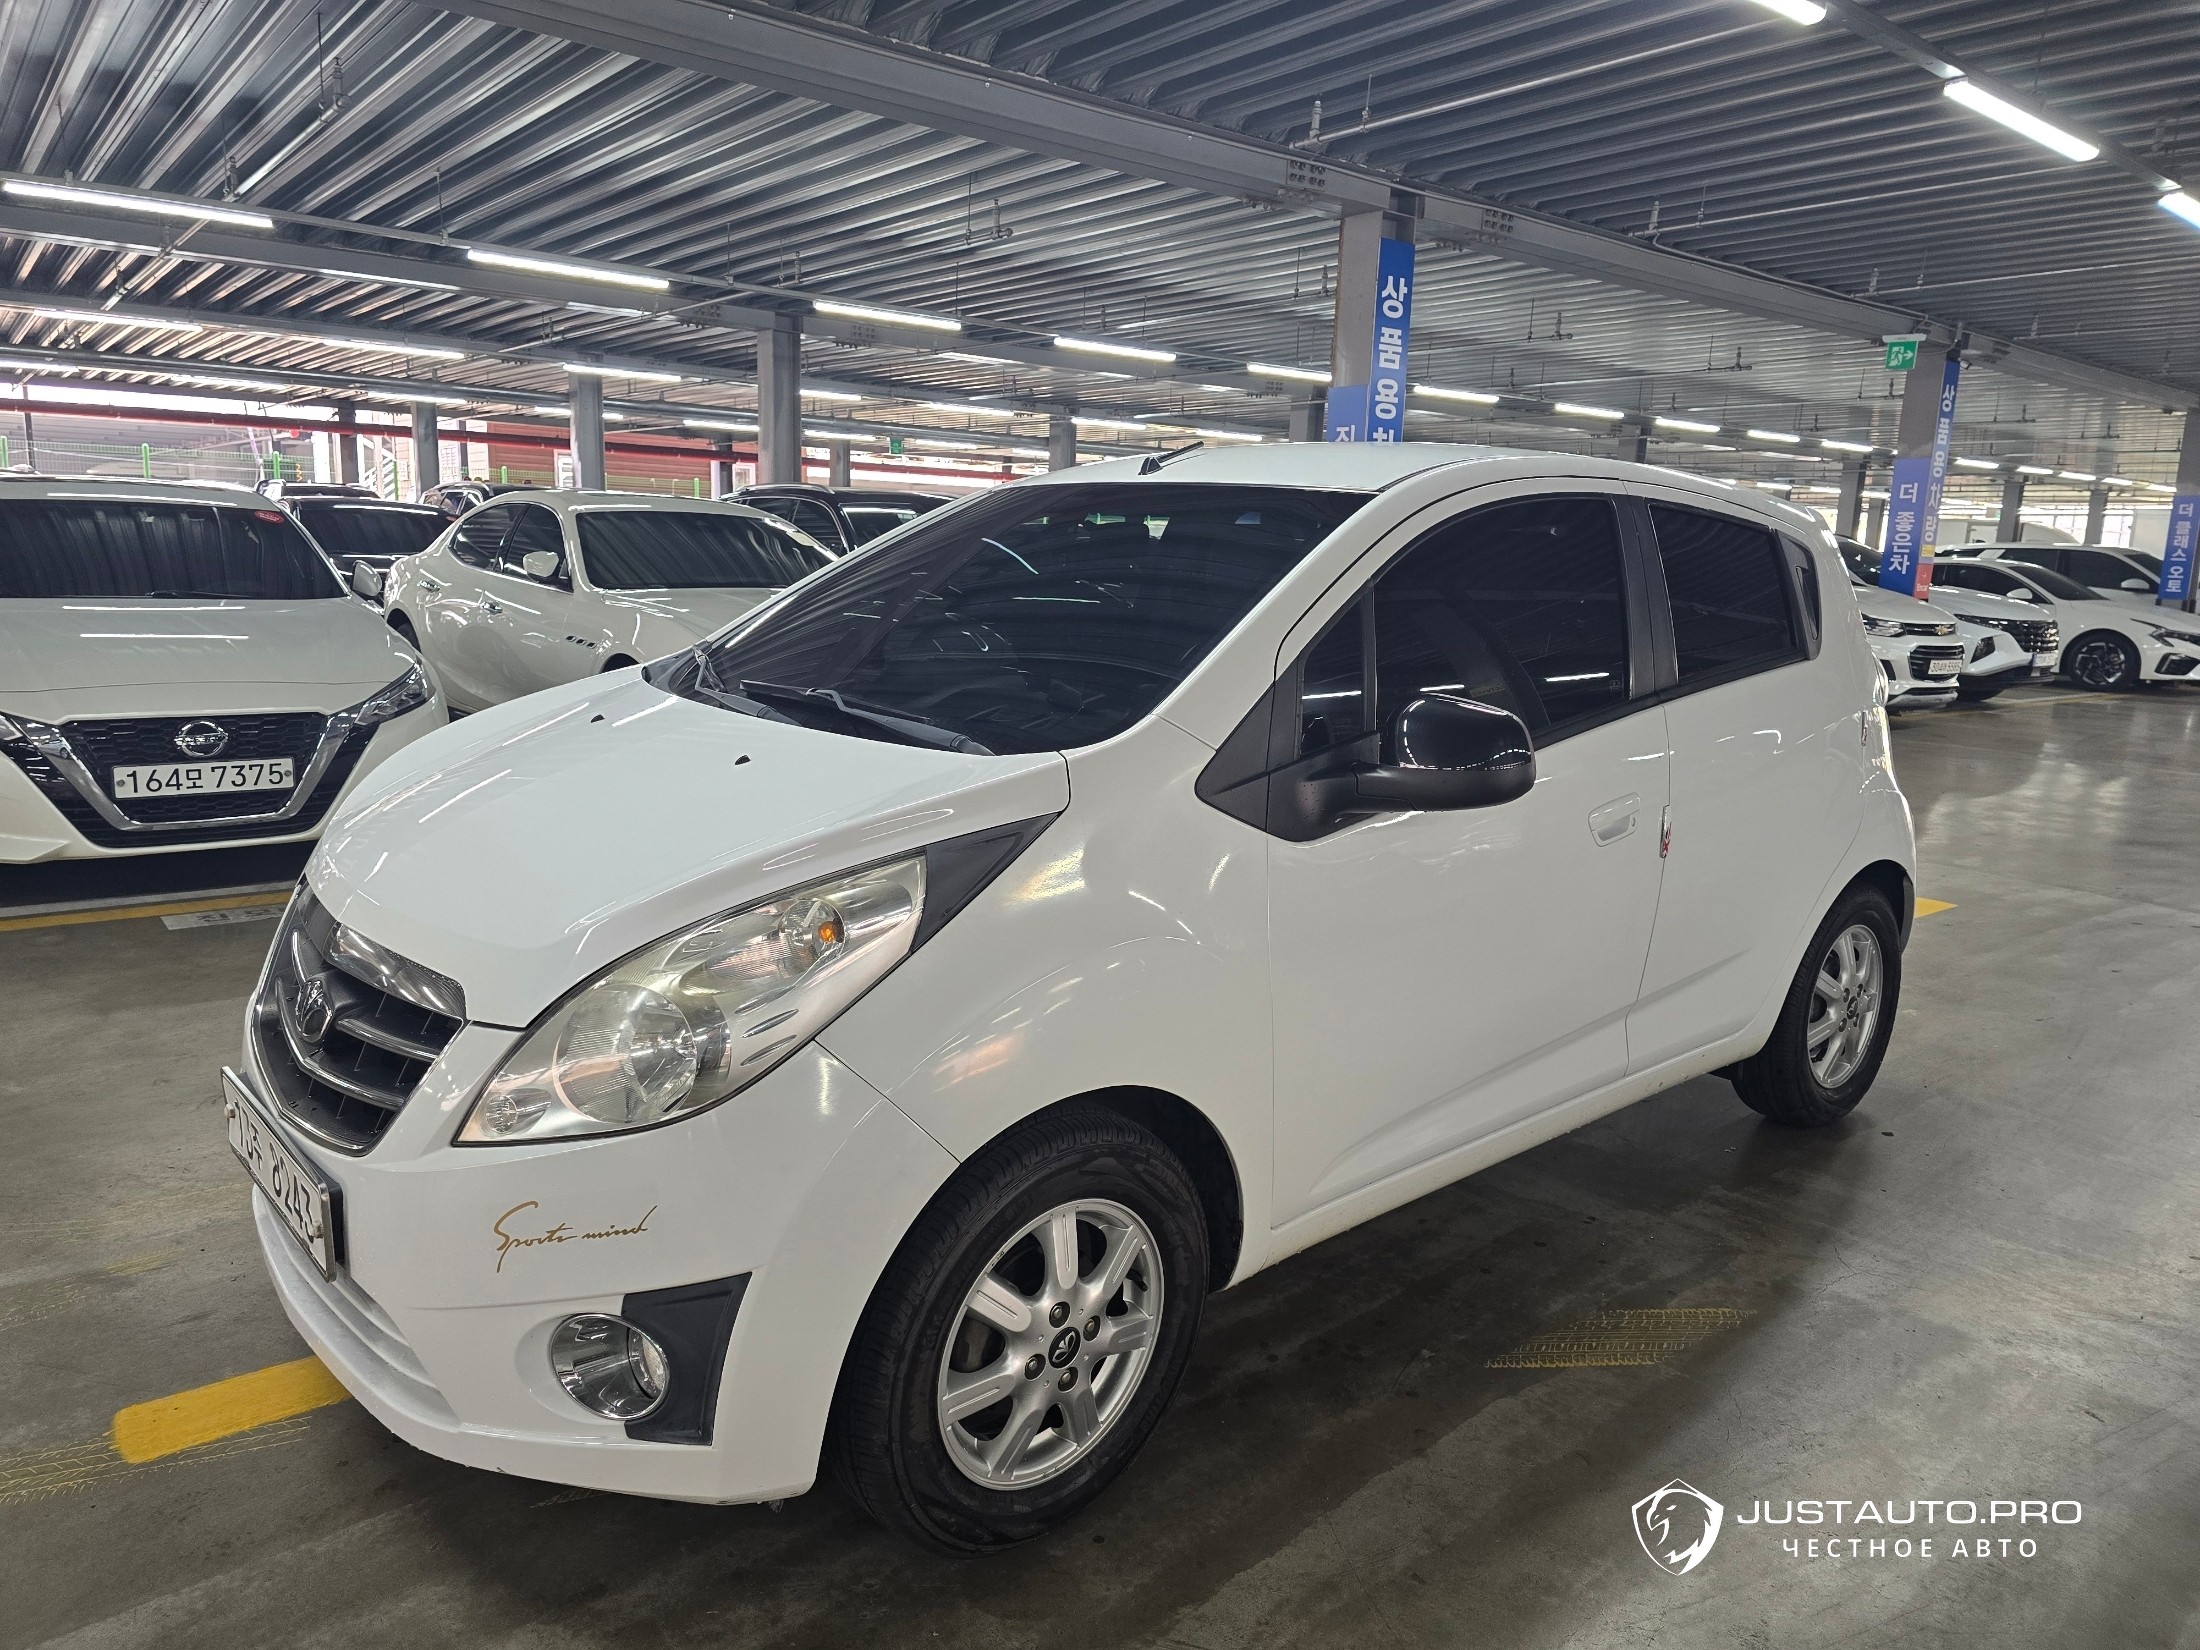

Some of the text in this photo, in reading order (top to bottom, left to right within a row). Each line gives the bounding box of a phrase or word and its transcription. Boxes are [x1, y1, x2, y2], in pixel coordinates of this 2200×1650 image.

[1888, 482, 1919, 575] 더 좋은차
[2178, 503, 2194, 517] 더
[2165, 565, 2184, 593] 오토
[126, 762, 284, 794] 164모 7375
[269, 1141, 315, 1244] 8243
[493, 1200, 658, 1273] Sports mind
